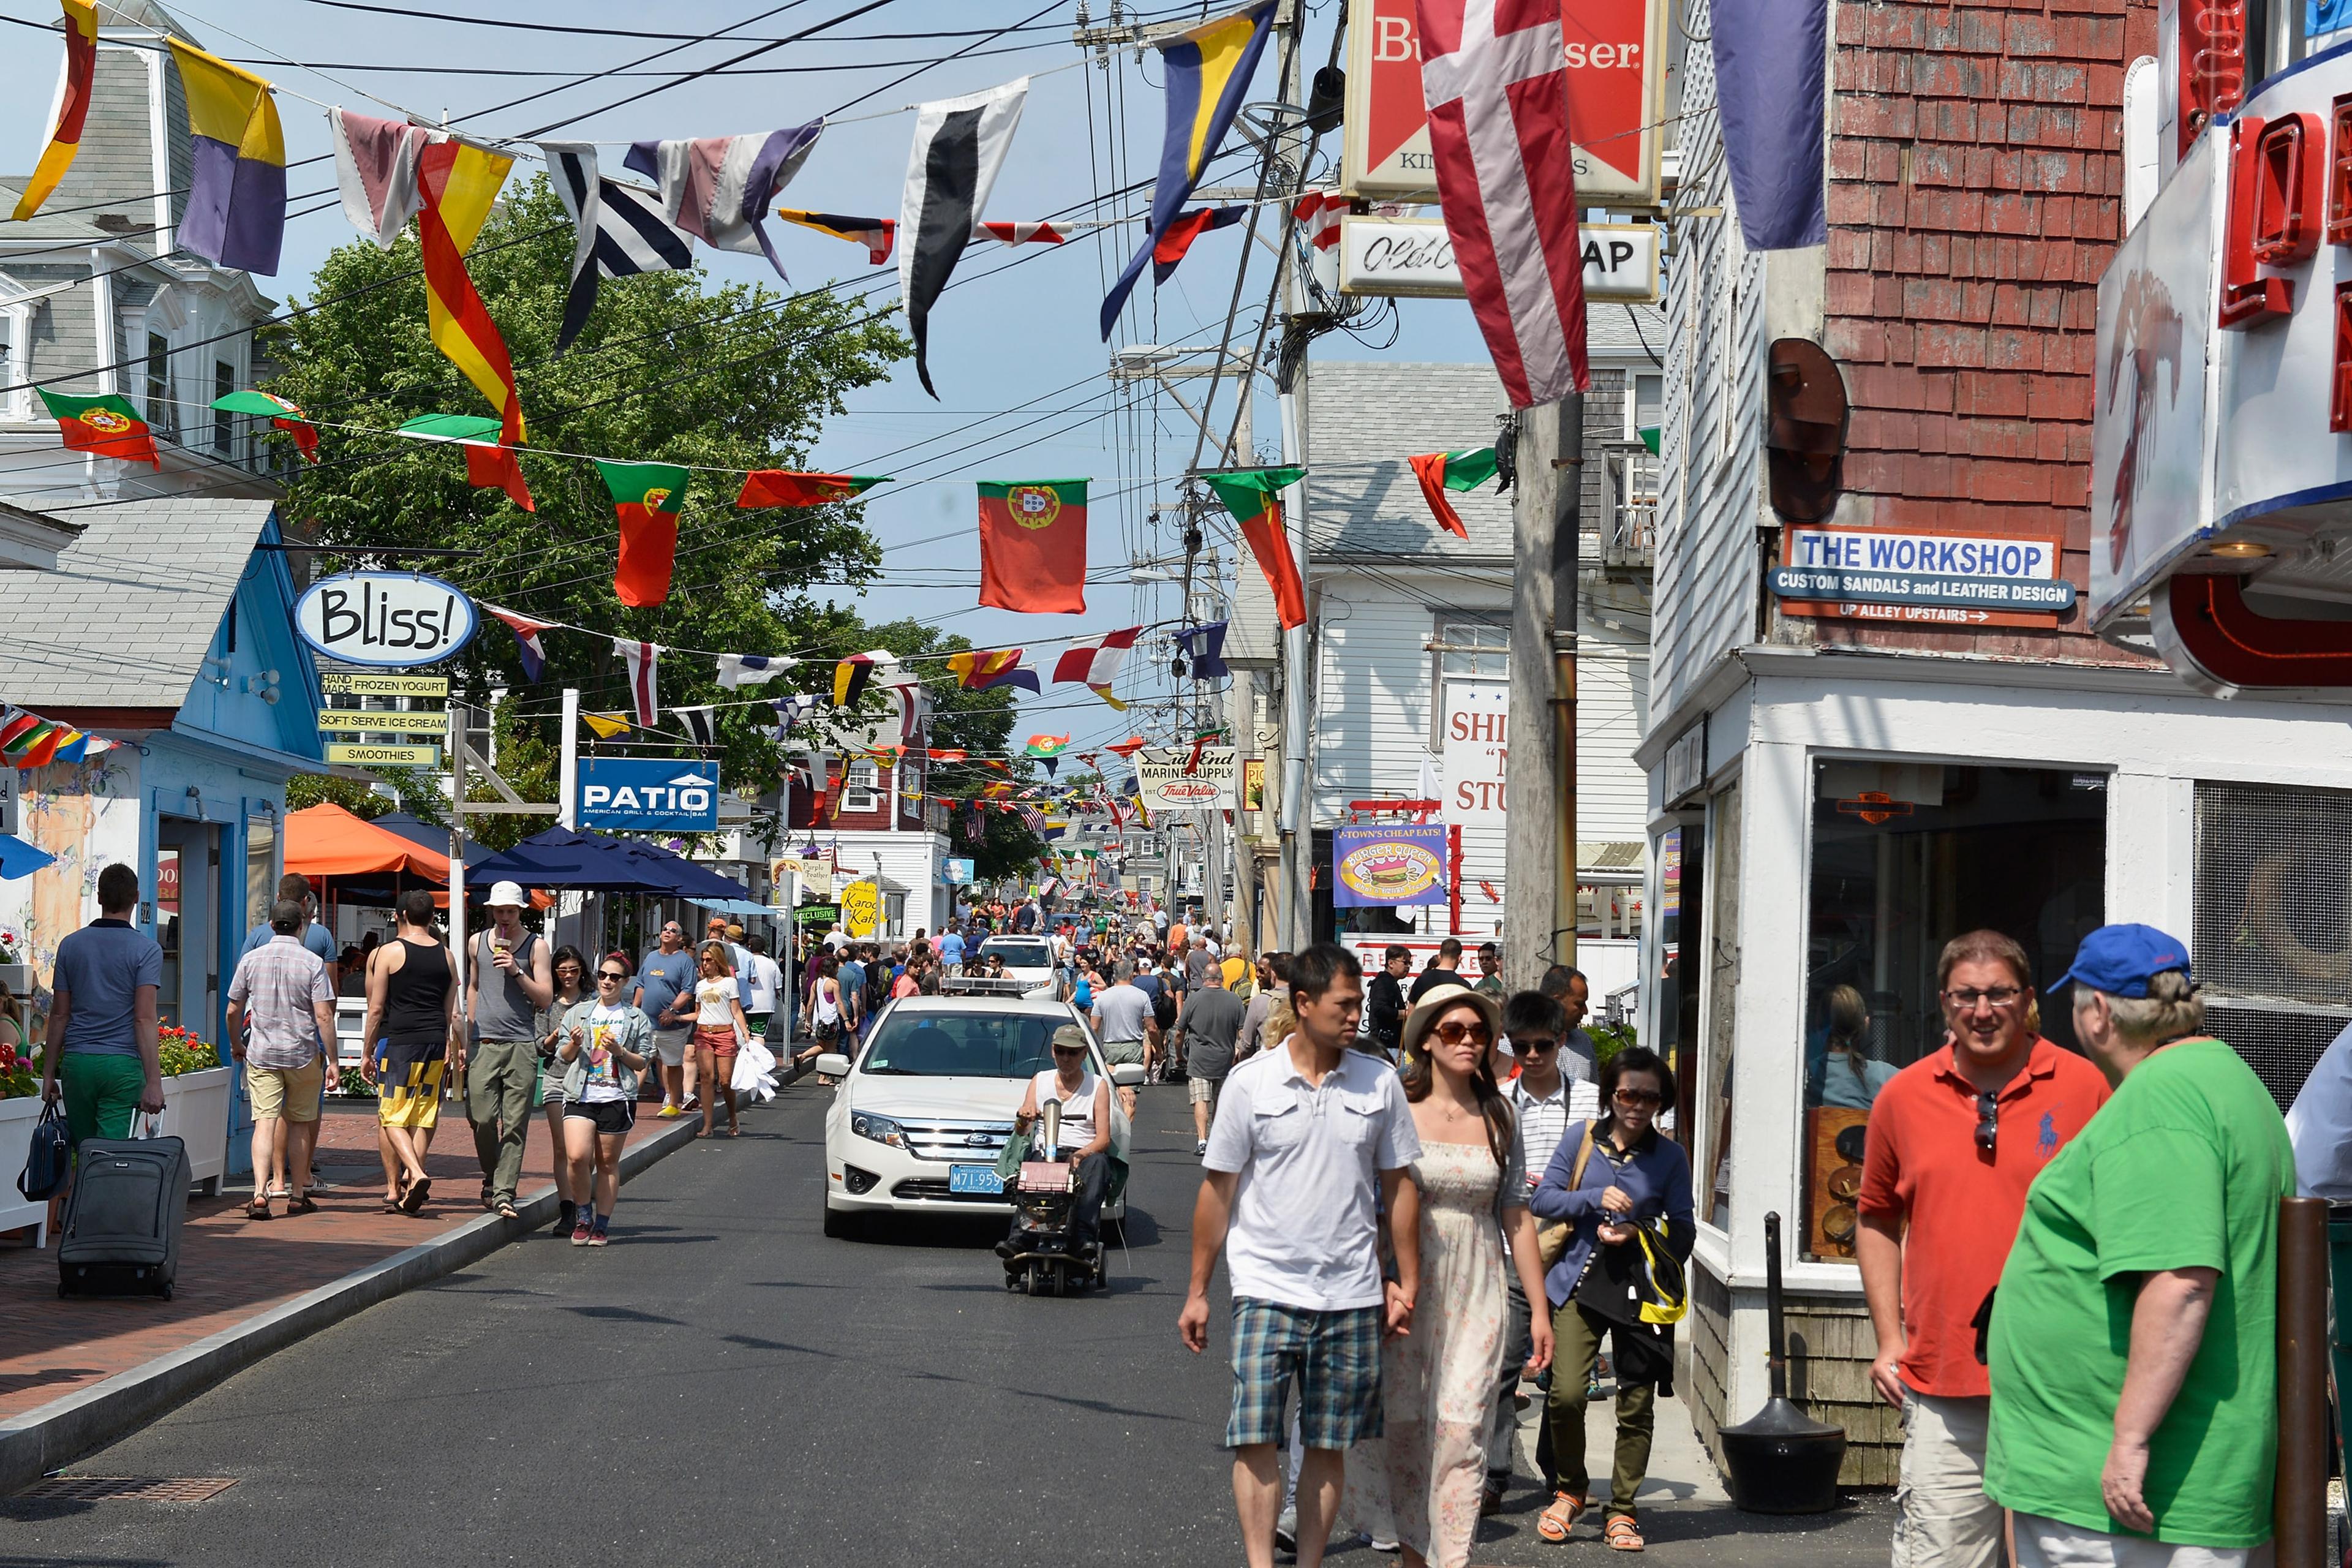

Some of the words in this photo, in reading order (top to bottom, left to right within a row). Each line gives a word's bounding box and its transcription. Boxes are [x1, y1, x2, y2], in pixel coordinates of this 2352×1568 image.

[1582, 240, 1634, 273] AP
[1803, 535, 1861, 567] THE
[1869, 538, 2042, 576] WORKSHOP
[1777, 571, 1839, 590] CUSTOM
[1842, 575, 1910, 595] SANDALS
[1913, 581, 1939, 595] and
[1942, 581, 2008, 600] LEATHER
[2011, 585, 2067, 603] DESIGN
[321, 581, 454, 650] Bliss!
[1839, 603, 1856, 616] UP
[1859, 604, 1900, 619] ALLEY
[1904, 606, 1967, 622] UPSTAIRS
[322, 675, 352, 684] HAND
[355, 680, 399, 691] FROZEN
[402, 681, 446, 692] YOGURT
[322, 685, 352, 694] MADE
[320, 715, 349, 726] SOFT
[351, 715, 386, 727] SERVE
[389, 717, 406, 728] ICE
[409, 718, 447, 729] CREAM
[347, 749, 415, 761] SMOOTHIES
[1199, 750, 1235, 765] End
[1142, 767, 1187, 778] MARINE
[1191, 767, 1234, 778] SUPPLY
[584, 785, 709, 811] PATIO
[1384, 829, 1414, 838] CHEAP
[1417, 828, 1441, 837] EATS!
[1346, 845, 1392, 867] BURGER
[1395, 845, 1433, 865] QUEEN
[803, 862, 824, 872] Purple
[805, 869, 828, 880] Feather
[1362, 953, 1417, 968] RET
